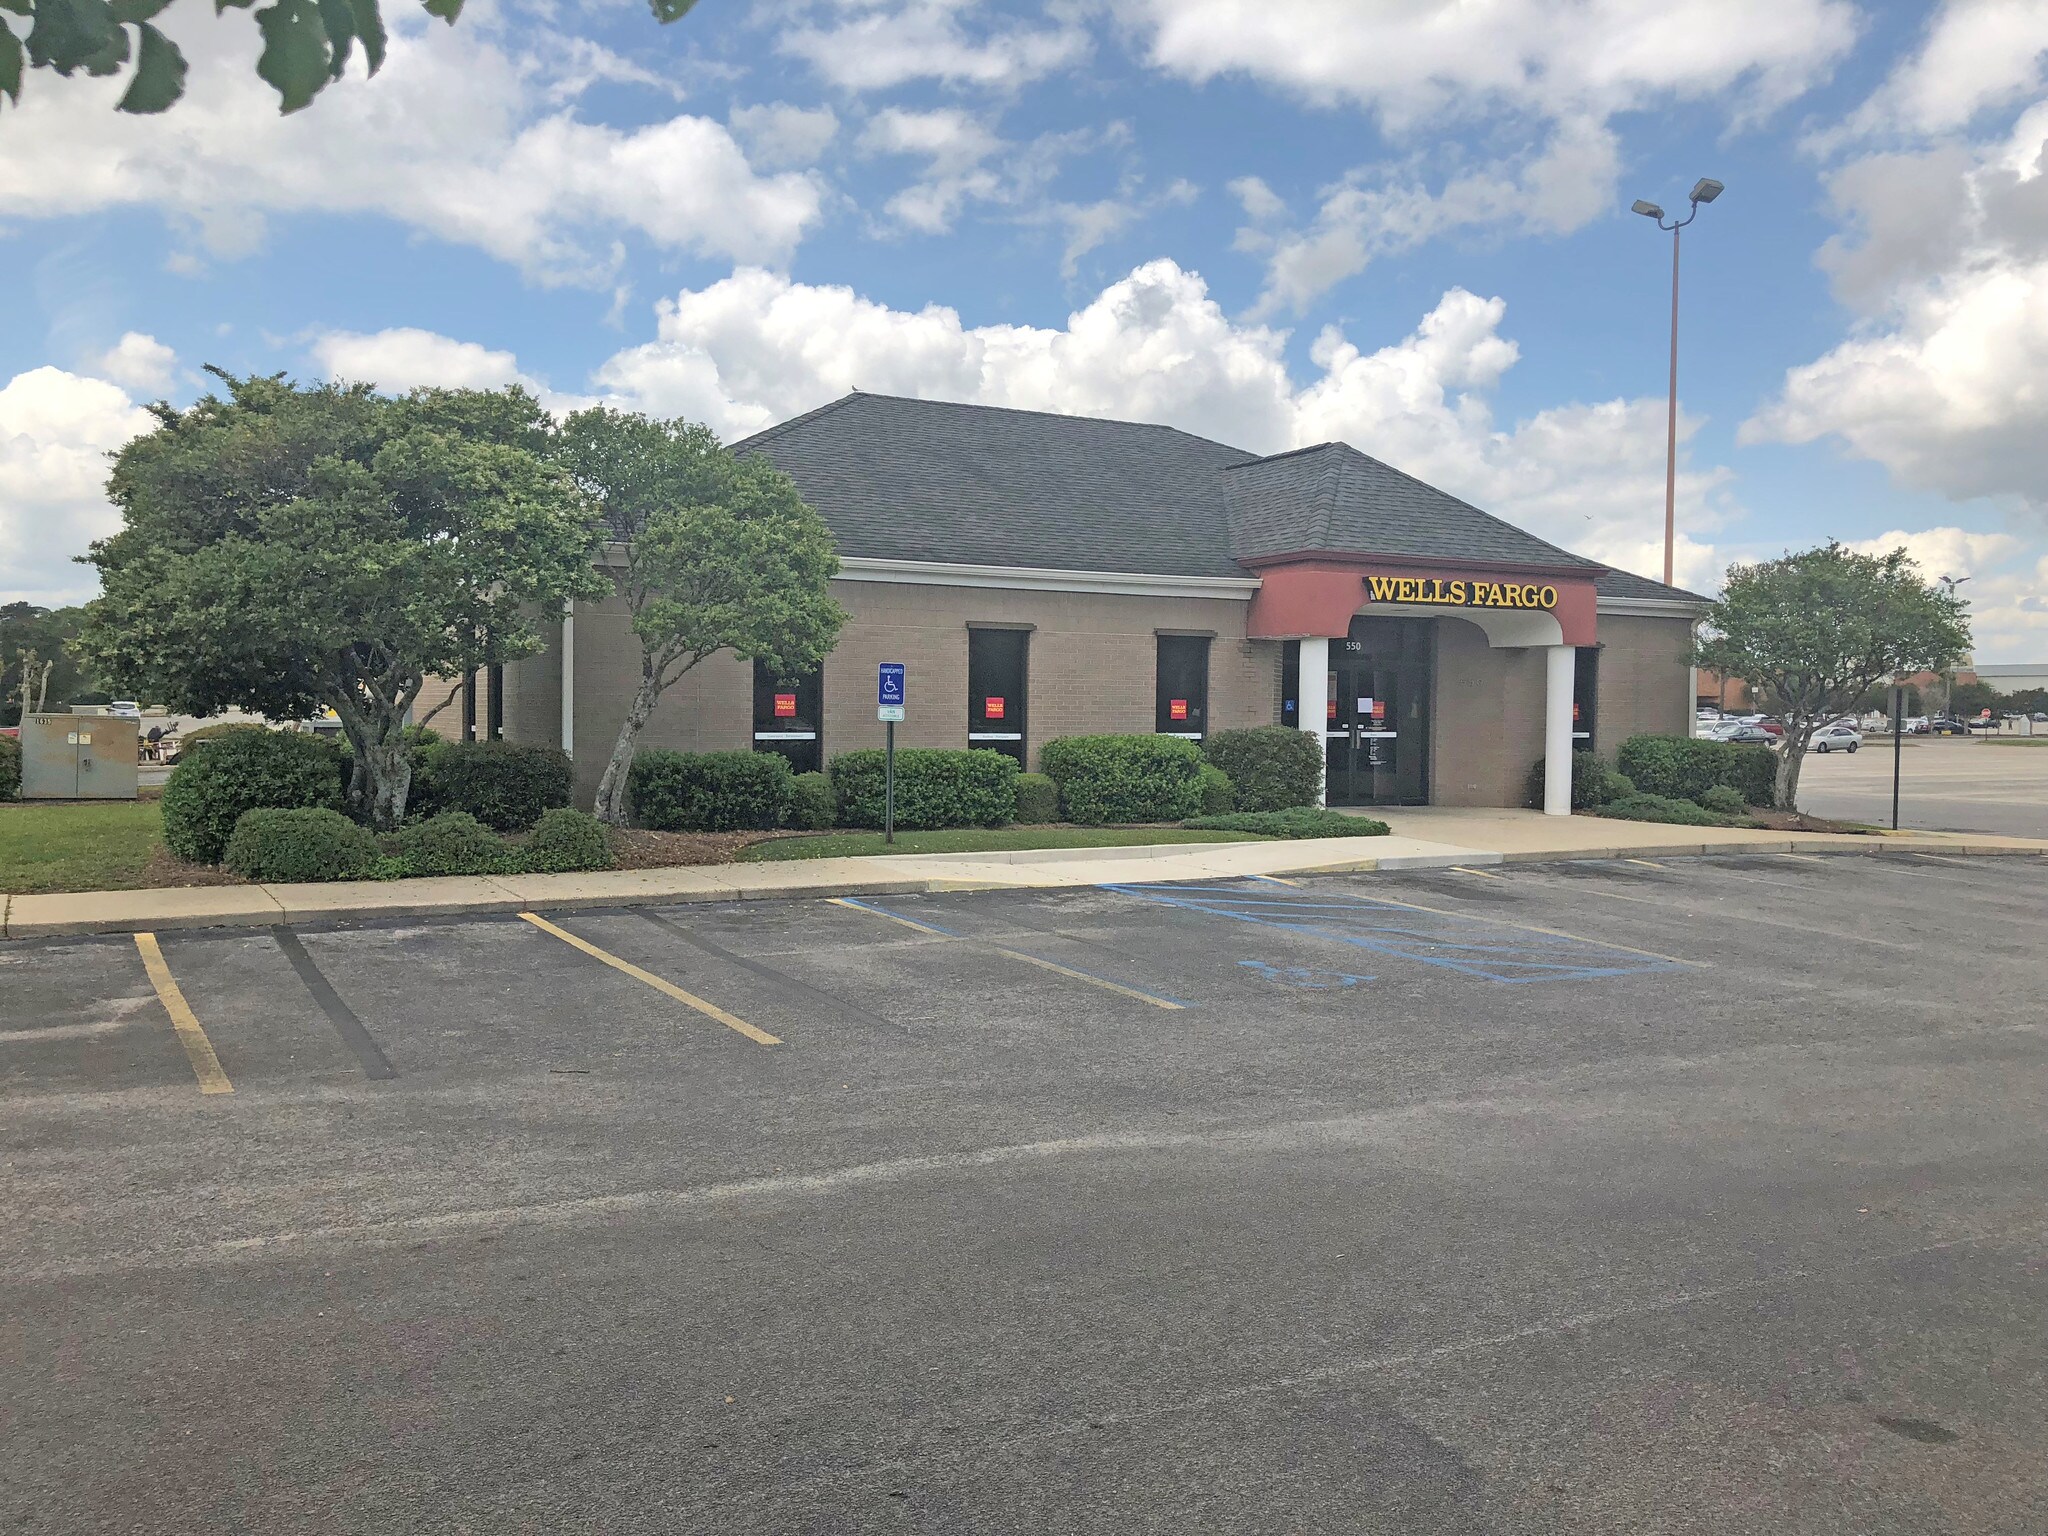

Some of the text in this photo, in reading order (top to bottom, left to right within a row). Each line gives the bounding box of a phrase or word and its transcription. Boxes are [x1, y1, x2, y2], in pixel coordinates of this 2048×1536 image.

[1368, 576, 1558, 608] WELLS FARGO
[1346, 642, 1361, 650] 550
